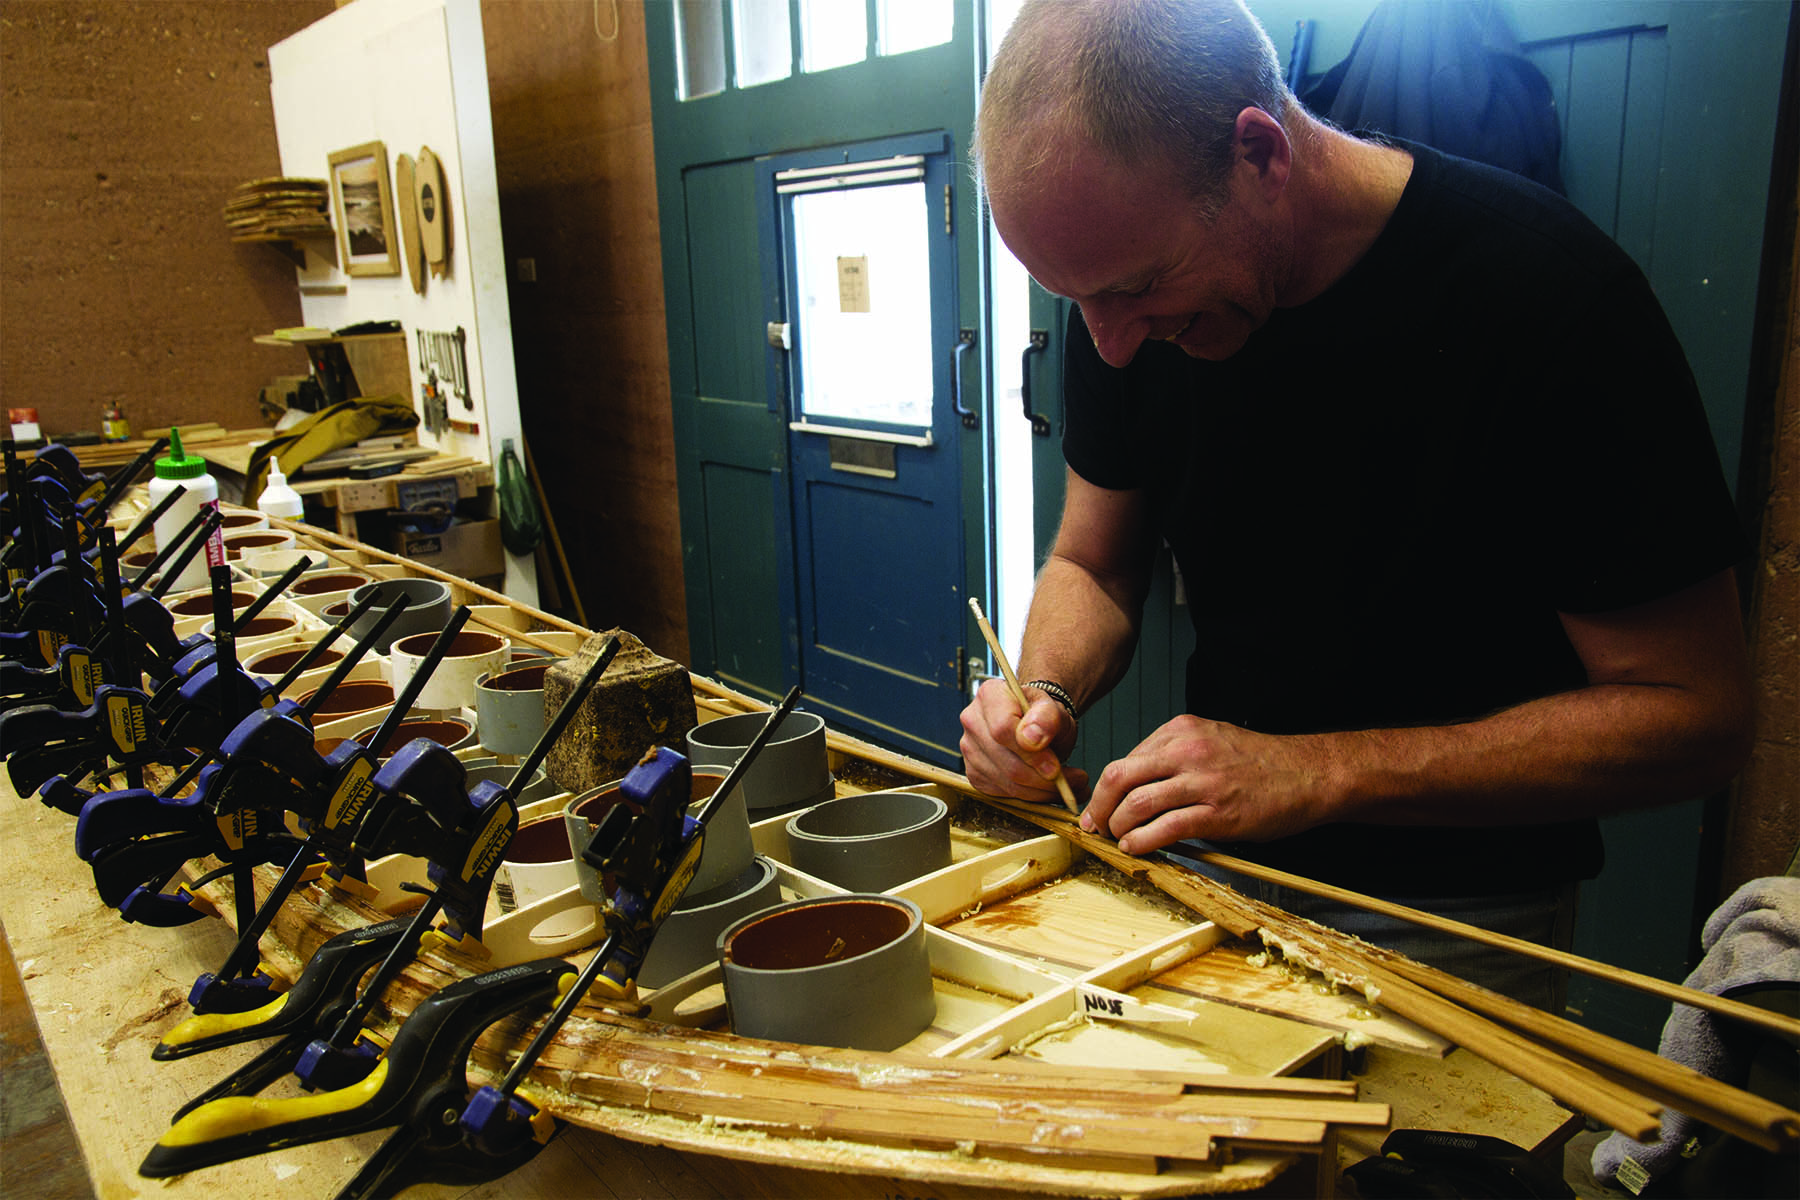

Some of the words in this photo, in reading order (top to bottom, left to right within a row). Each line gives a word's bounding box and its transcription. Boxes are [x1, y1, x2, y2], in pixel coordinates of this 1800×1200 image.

[91, 663, 104, 691] IRW
[121, 707, 133, 743] QUICK-GRIP
[131, 704, 147, 742] IRWIN
[335, 776, 365, 820] QUICK-GRIP
[340, 780, 375, 825] IRWIN
[243, 809, 257, 837] WIN
[472, 824, 504, 871] QUICK-GRIP
[476, 828, 513, 878] IRWIN
[1084, 993, 1123, 1016] NOSE
